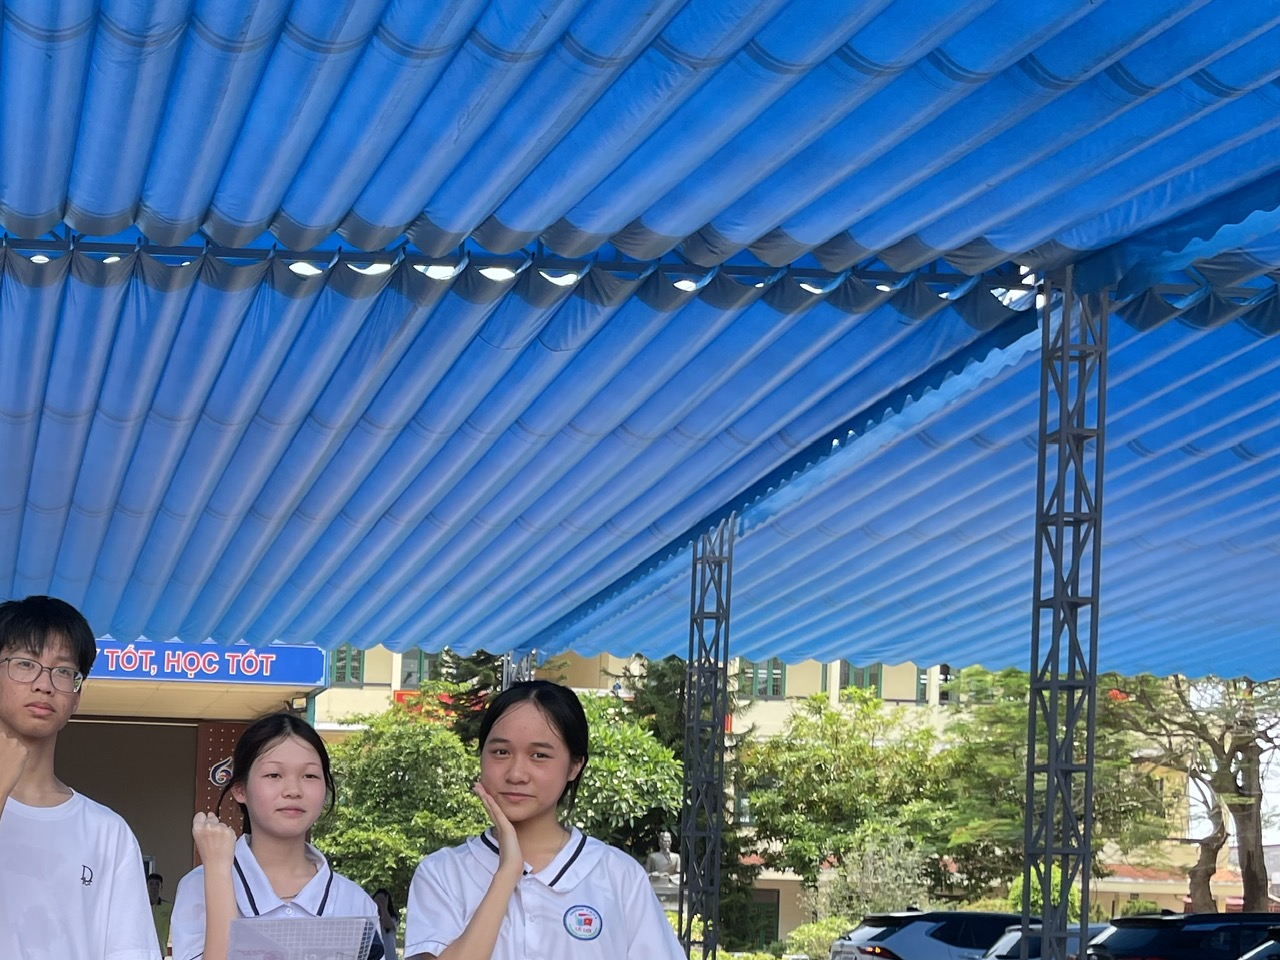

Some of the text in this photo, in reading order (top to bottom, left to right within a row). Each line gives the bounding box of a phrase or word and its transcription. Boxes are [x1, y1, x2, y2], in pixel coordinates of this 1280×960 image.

[104, 644, 158, 676] TỐT,
[164, 650, 219, 678] HỌC
[225, 648, 276, 676] TỐT
